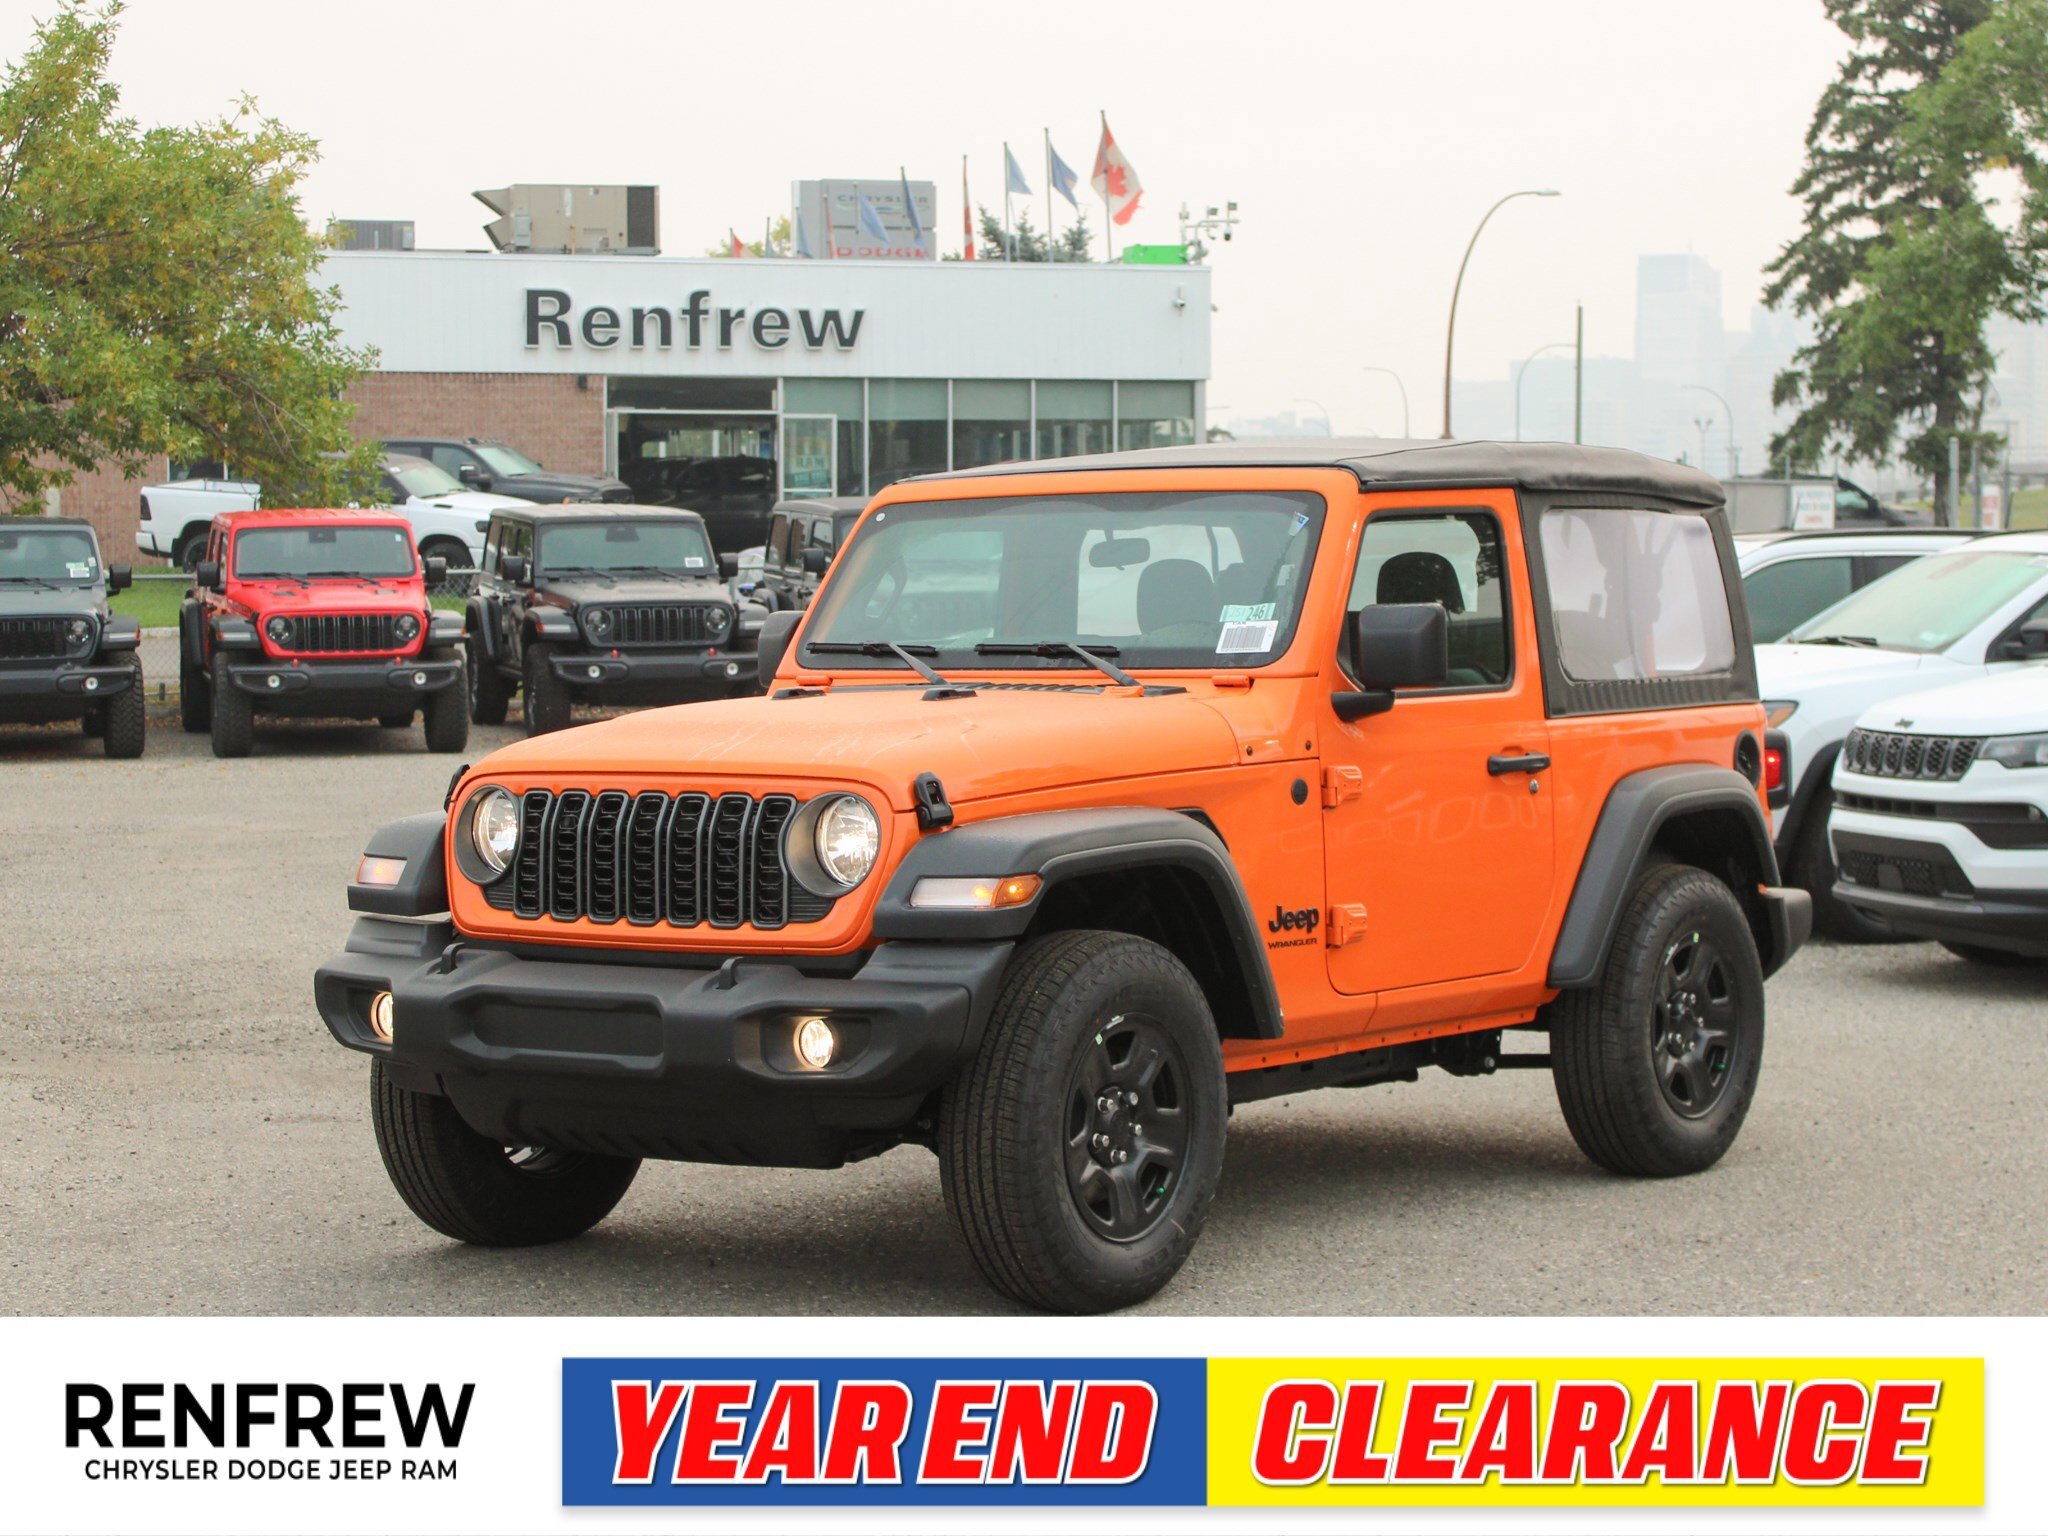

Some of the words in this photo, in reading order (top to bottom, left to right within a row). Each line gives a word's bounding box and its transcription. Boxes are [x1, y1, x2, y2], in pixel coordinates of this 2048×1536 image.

[525, 288, 865, 350] Renfrew
[1268, 904, 1319, 933] Jeep
[1268, 937, 1318, 950] WRANGLER
